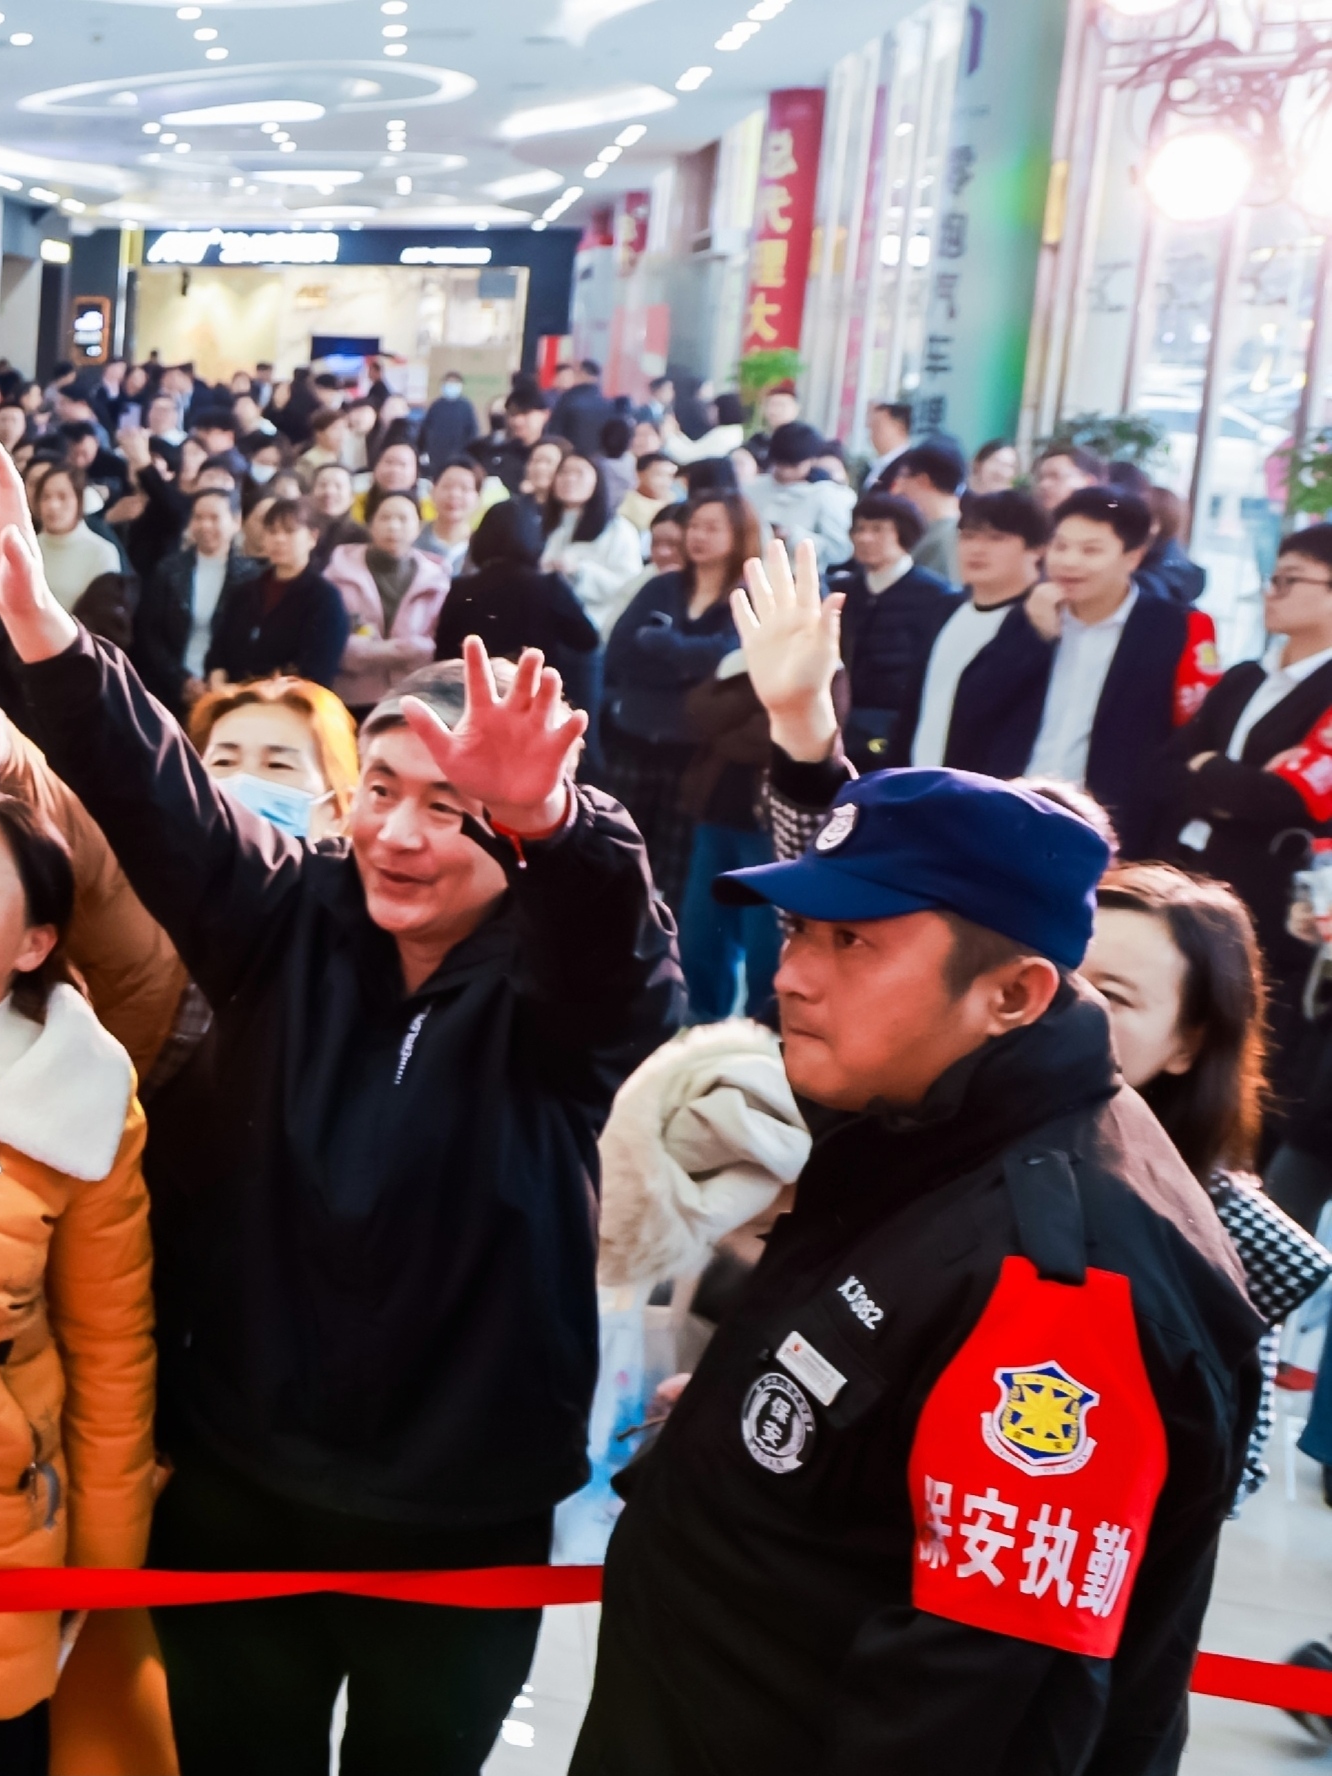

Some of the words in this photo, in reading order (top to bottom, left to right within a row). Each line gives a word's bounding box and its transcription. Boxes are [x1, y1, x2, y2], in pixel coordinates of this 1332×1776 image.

[760, 1396, 792, 1447] 保安
[918, 1474, 1132, 1618] 保安执勤
